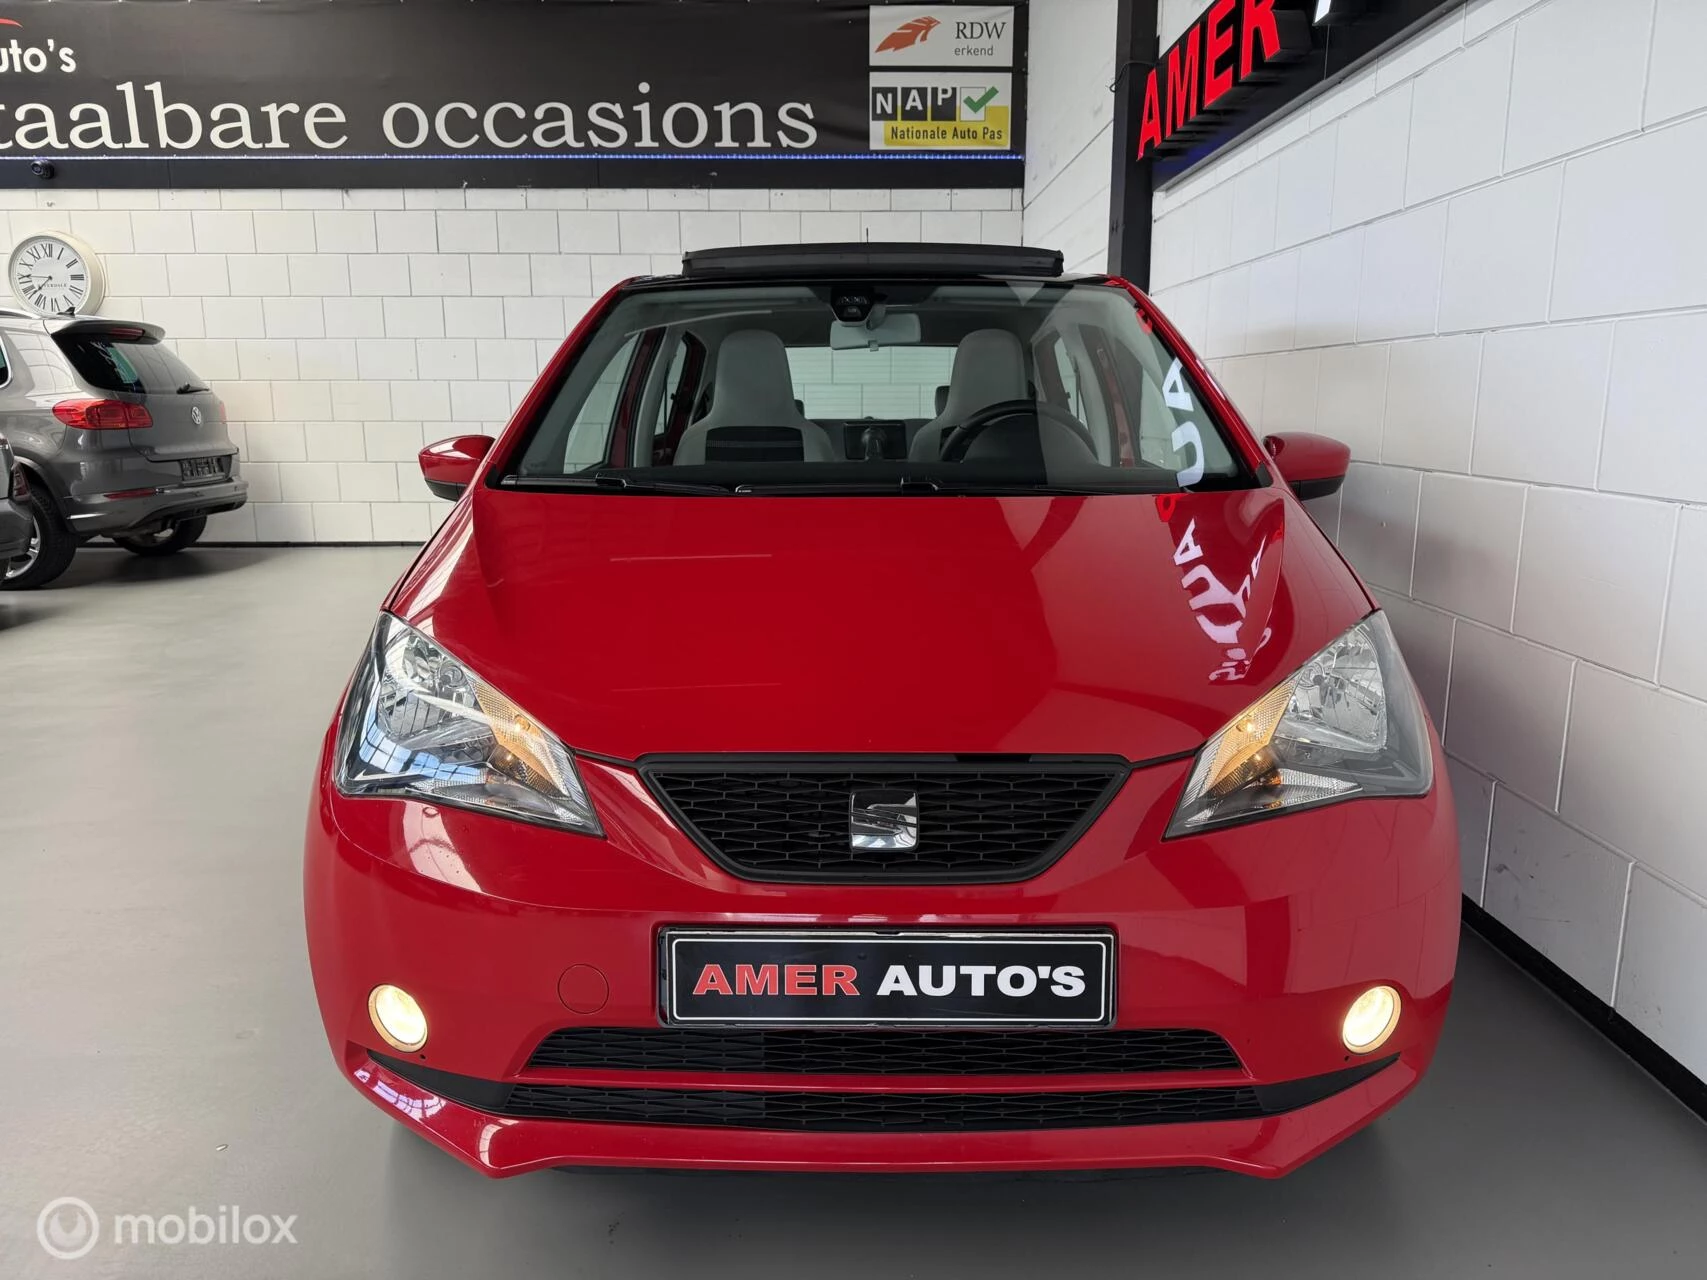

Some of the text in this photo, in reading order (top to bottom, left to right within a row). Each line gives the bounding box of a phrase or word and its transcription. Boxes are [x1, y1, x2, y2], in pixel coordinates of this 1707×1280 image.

[955, 21, 1007, 40] RDW
[954, 45, 994, 57] erkend
[1137, 0, 1281, 161] AMER
[382, 81, 818, 149] occasions
[876, 86, 953, 115] NAP
[891, 126, 1003, 140] Nationale Auto Pas
[692, 963, 1086, 998] AMER AUTO'S
